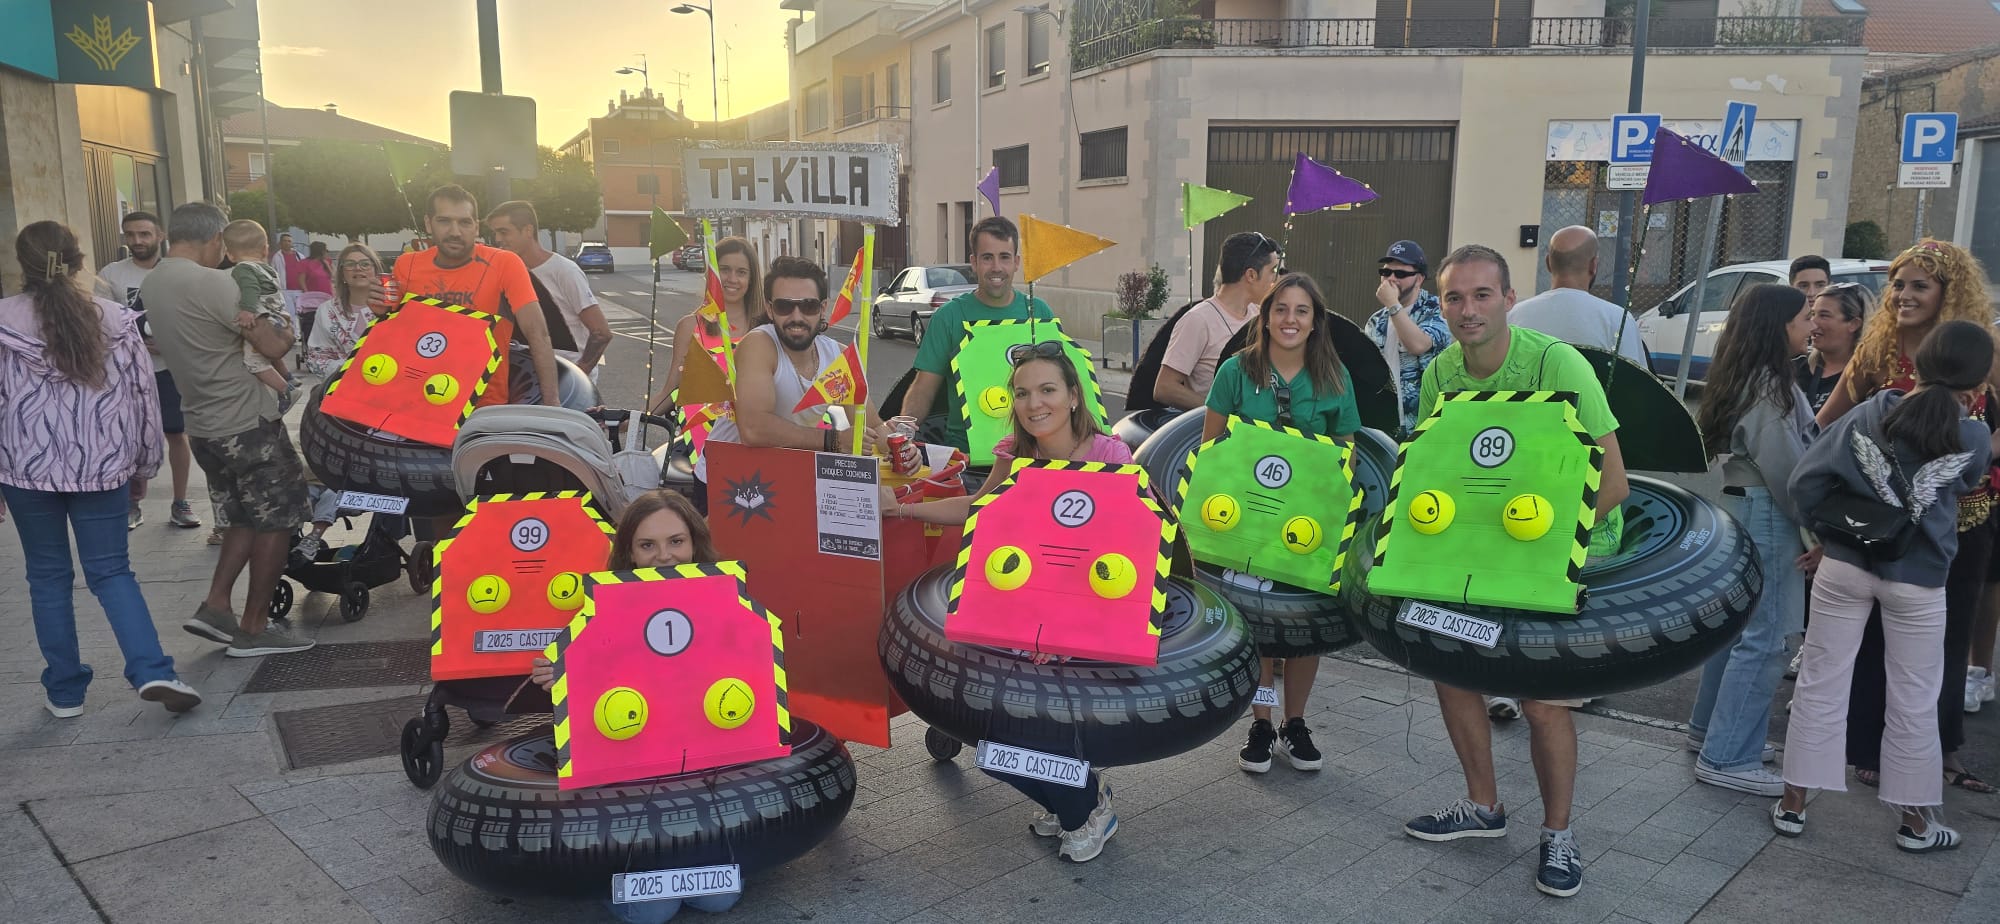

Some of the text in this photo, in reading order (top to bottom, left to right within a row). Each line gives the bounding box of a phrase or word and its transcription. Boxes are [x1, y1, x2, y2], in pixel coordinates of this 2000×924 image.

[1617, 120, 1648, 158] P
[1912, 119, 1945, 158] P
[420, 336, 442, 353] 33
[1479, 436, 1505, 458] 89
[821, 467, 844, 478] CHOQUES
[1261, 462, 1285, 482] 46
[343, 494, 404, 511] 2025 CASTIZOS
[1060, 498, 1086, 519] 22
[518, 526, 542, 545] 99
[664, 620, 673, 645] 1
[1410, 606, 1440, 626] 2025
[1441, 615, 1495, 642] CASTIZOS
[487, 633, 513, 648] 2025
[989, 748, 1020, 770] 2025
[1025, 755, 1082, 782] CASTIZOS
[630, 875, 664, 897] 2025
[671, 869, 733, 893] CASTIZOS
